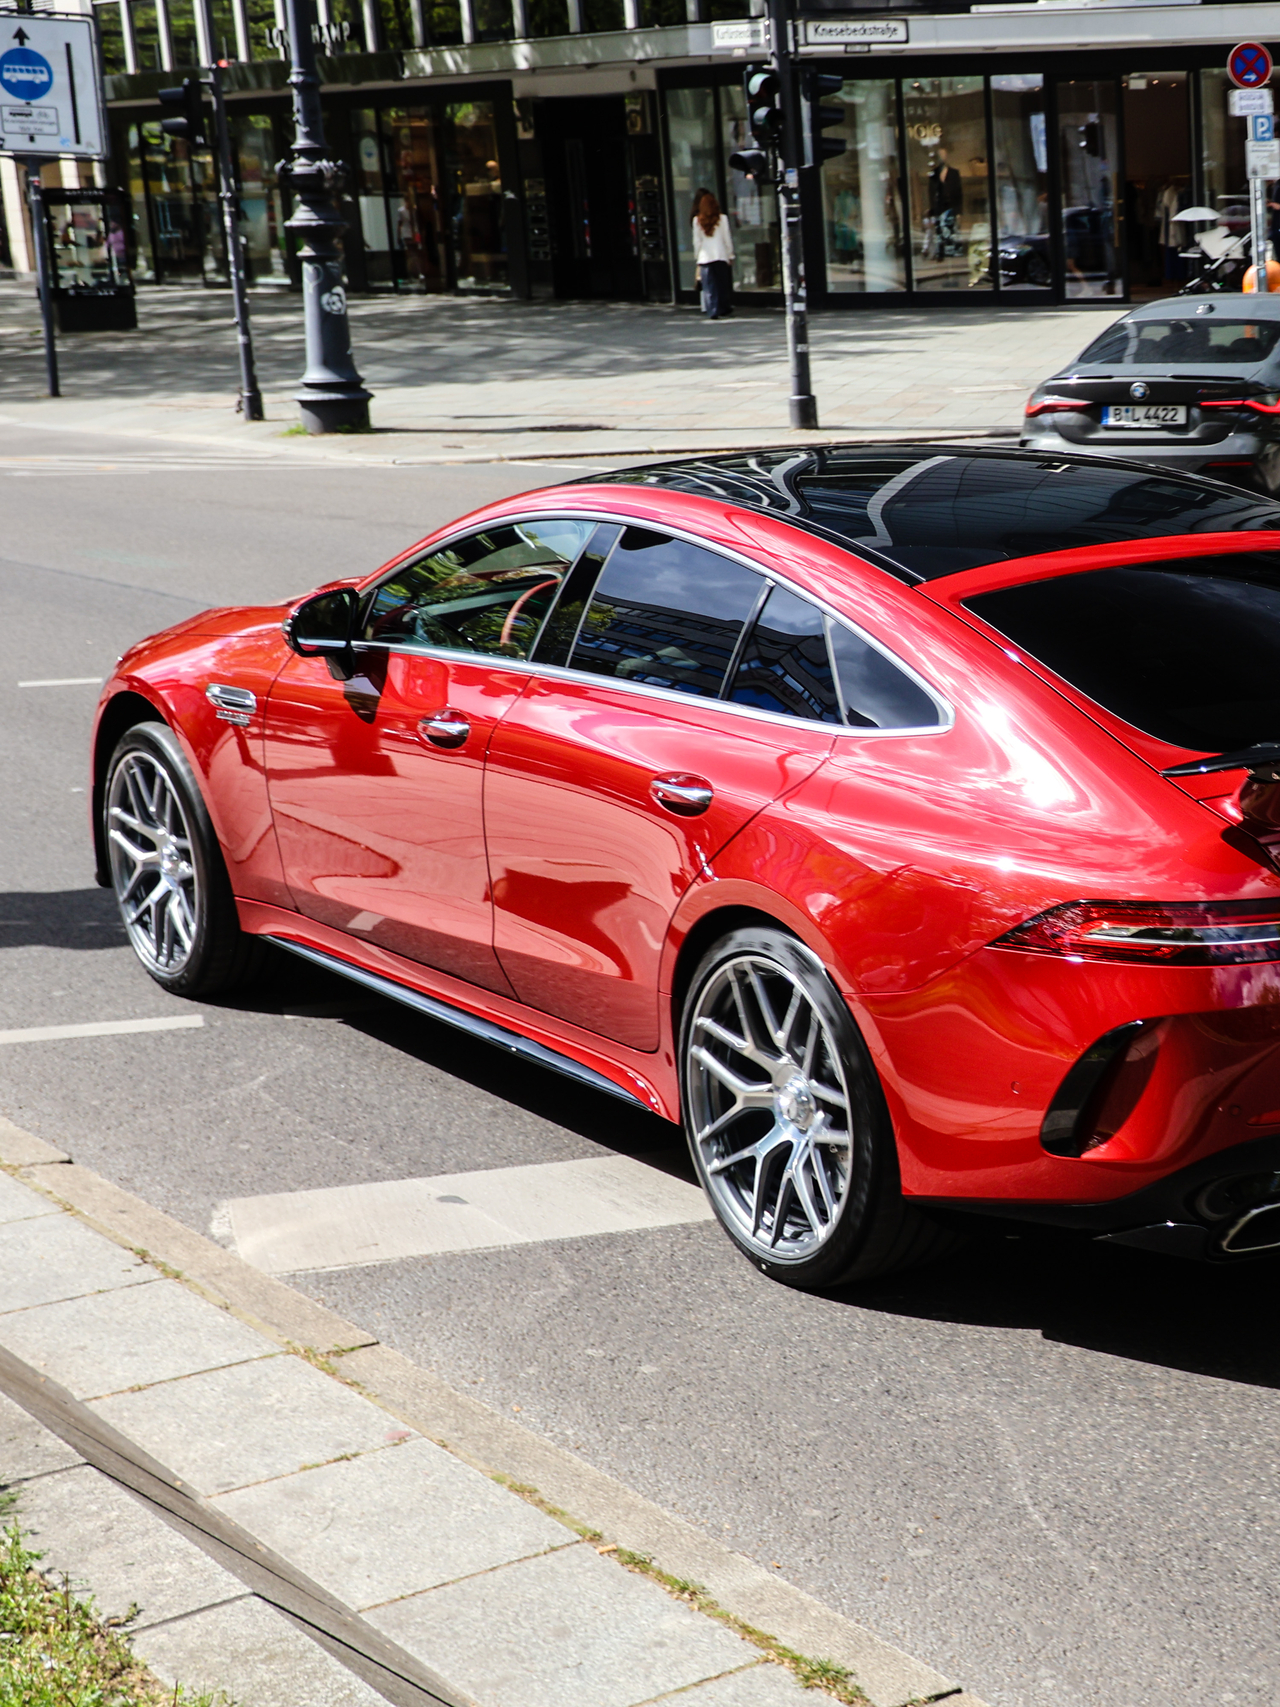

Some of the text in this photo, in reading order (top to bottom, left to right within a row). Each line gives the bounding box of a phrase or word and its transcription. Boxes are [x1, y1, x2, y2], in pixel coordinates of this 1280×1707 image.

[813, 23, 899, 39] Knesebeckstraße
[1113, 407, 1179, 422] B L 4422
